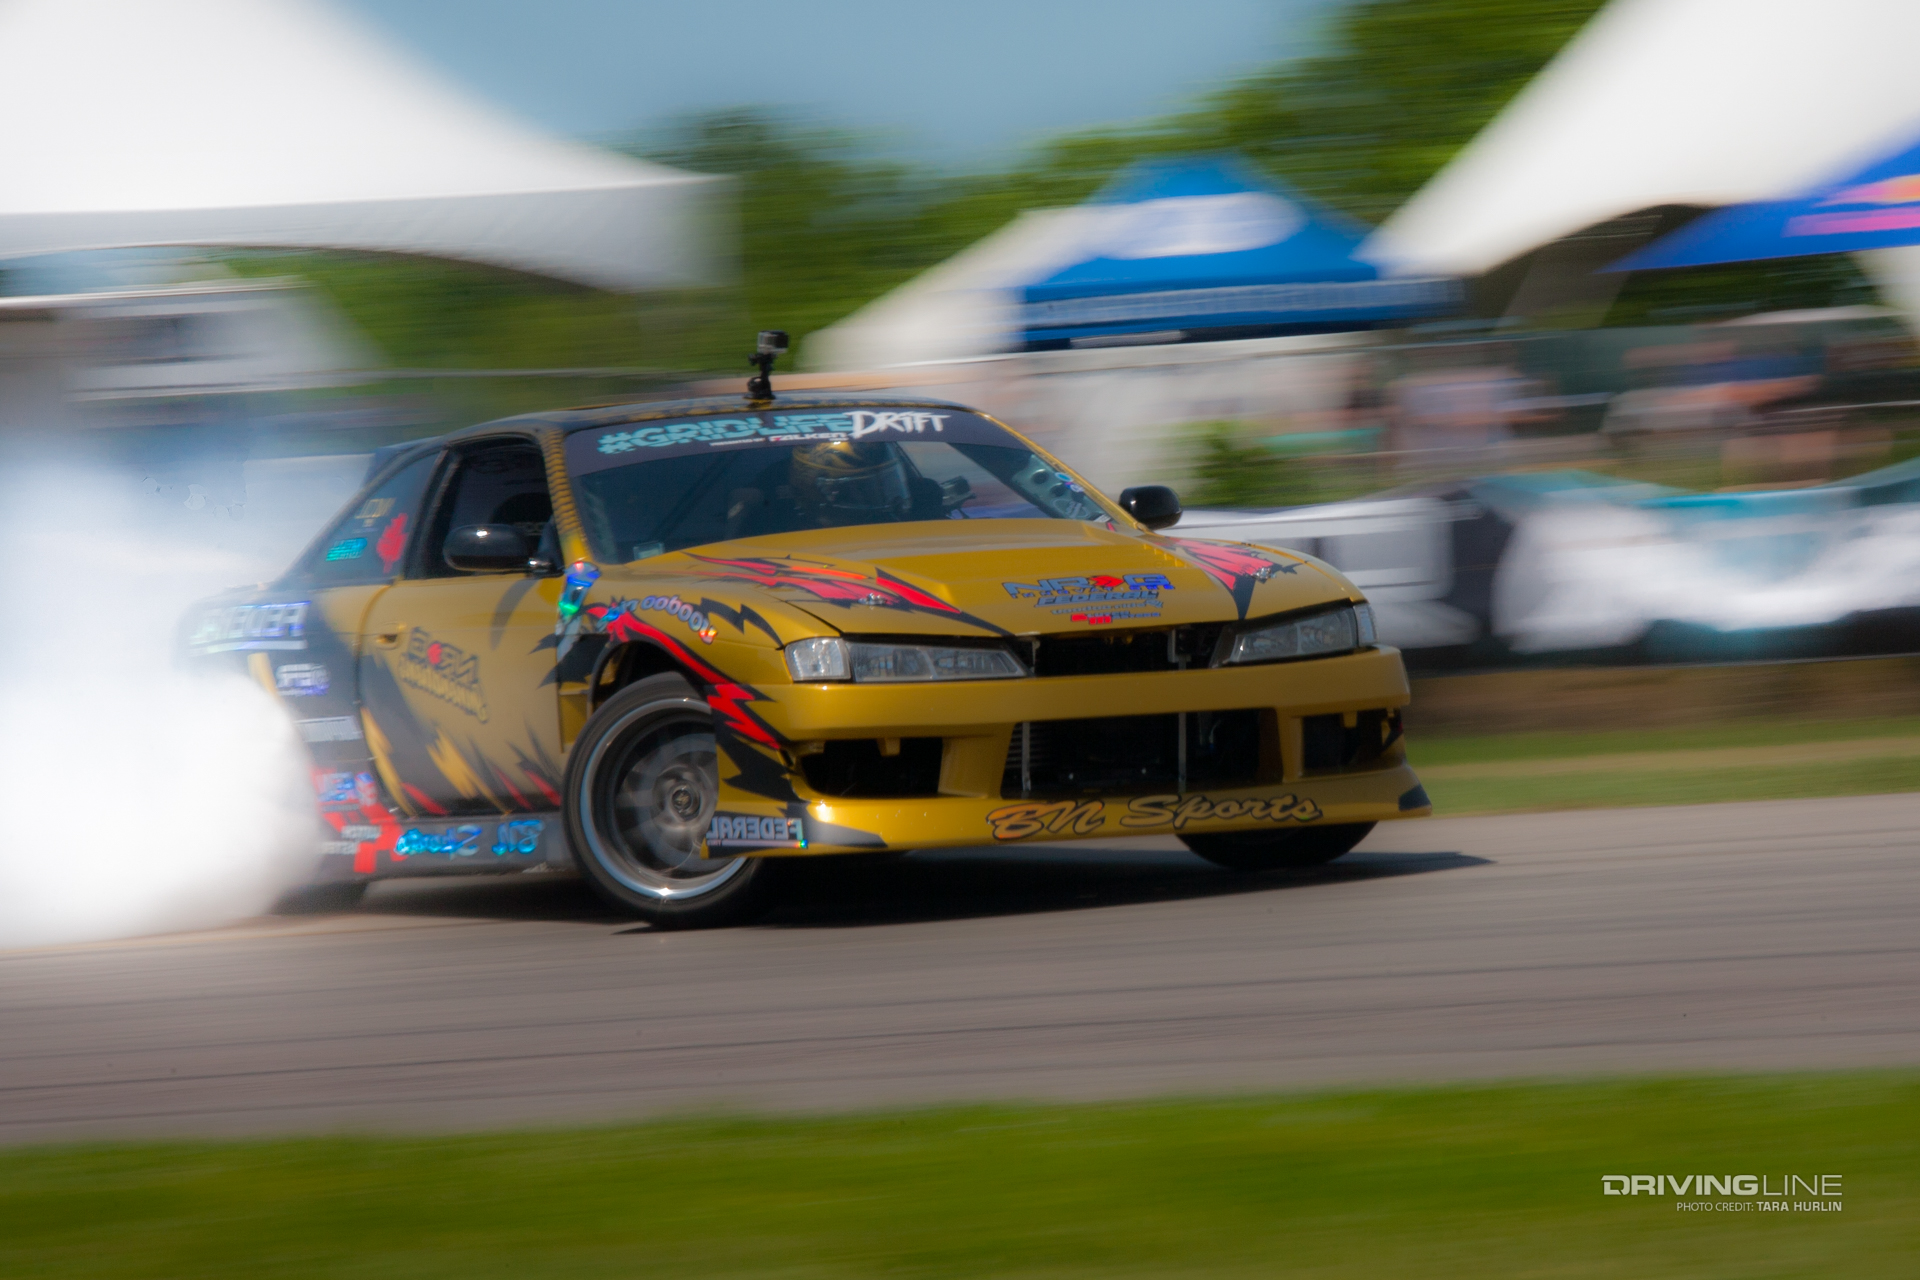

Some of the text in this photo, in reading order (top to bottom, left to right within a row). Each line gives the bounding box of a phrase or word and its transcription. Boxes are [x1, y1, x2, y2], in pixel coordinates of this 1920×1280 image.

[768, 432, 848, 443] FALKEN
[1035, 591, 1159, 607] FEDERAL
[986, 793, 1324, 841] BN Sports
